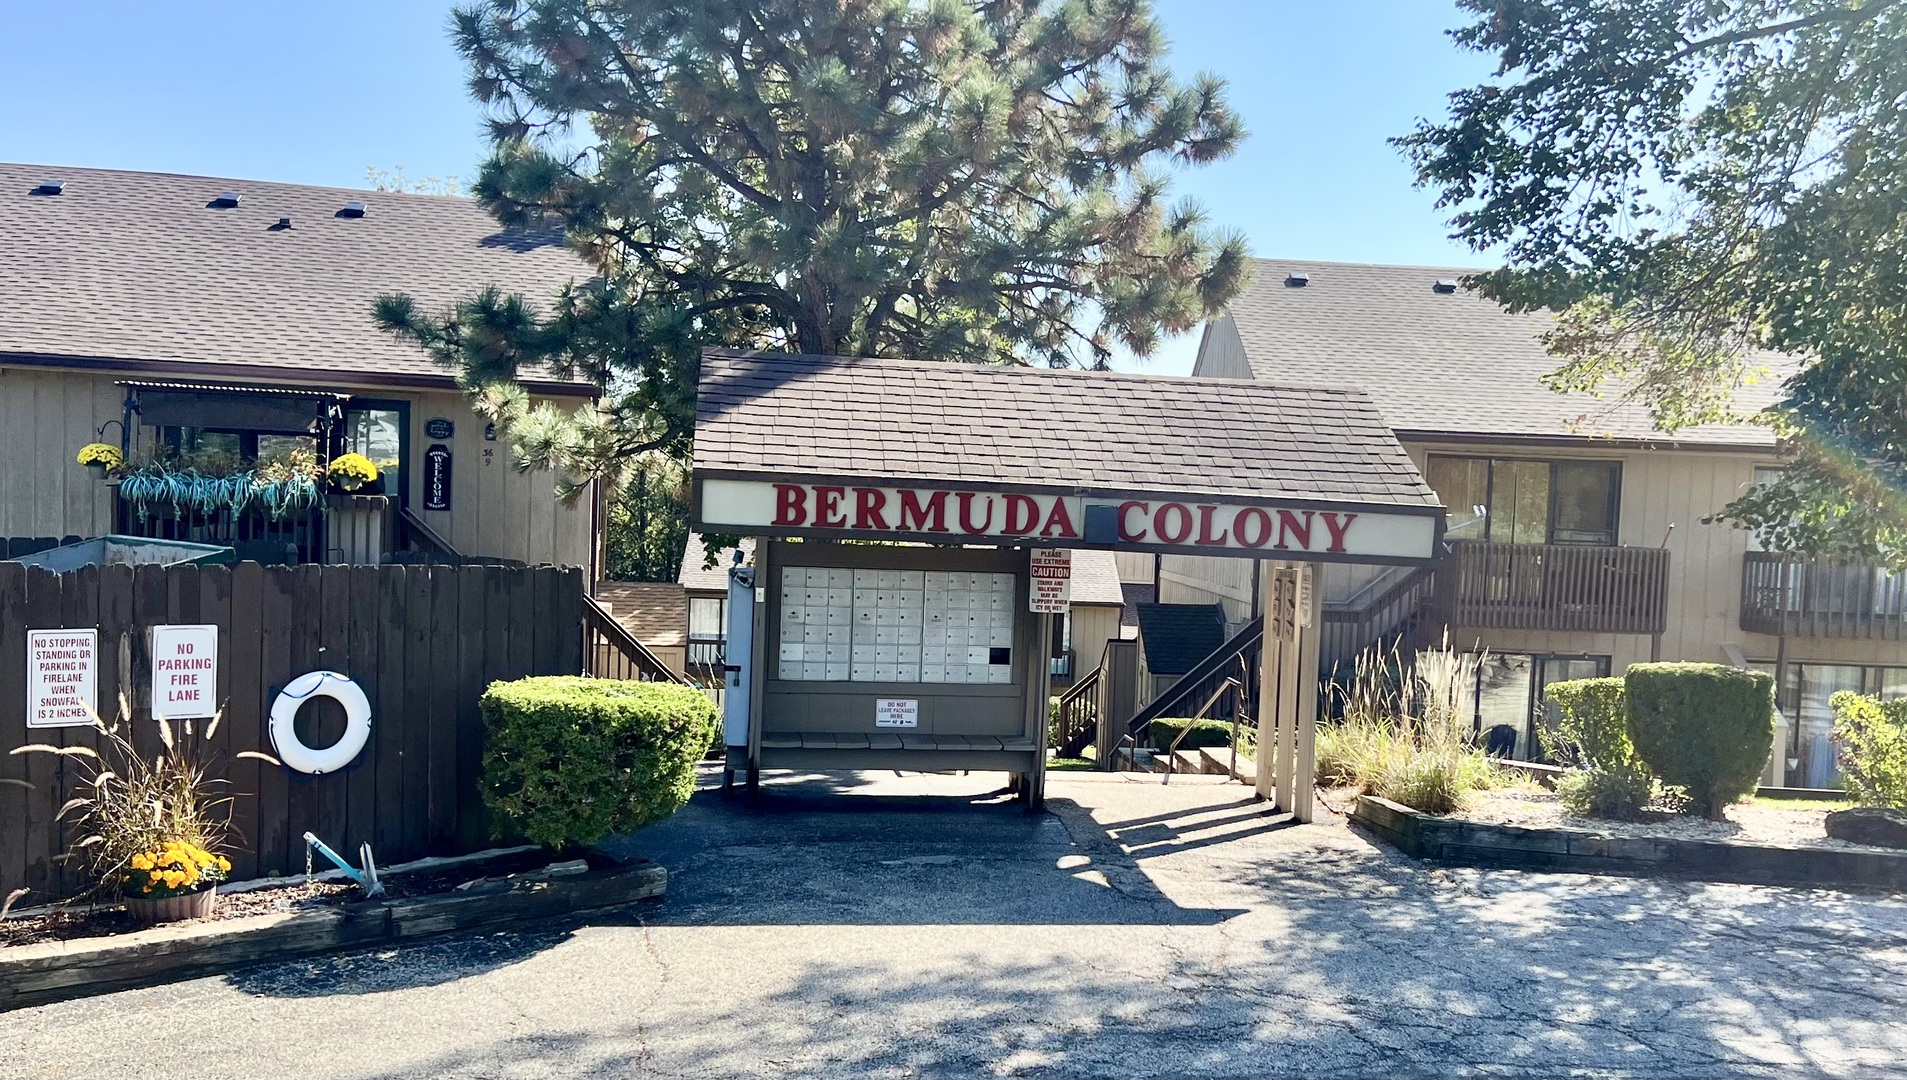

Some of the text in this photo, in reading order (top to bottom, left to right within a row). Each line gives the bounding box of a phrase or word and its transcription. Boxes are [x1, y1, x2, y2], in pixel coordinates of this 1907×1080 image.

[433, 456, 442, 503] WELCOME
[771, 484, 1358, 552] BERMUDA COLONY
[1032, 567, 1069, 577] CAUTION
[35, 639, 46, 648] NO
[178, 644, 194, 654] NO
[36, 650, 90, 660] STANDING OR
[40, 662, 87, 671] PARKING IN
[158, 658, 211, 670] PARKING
[44, 673, 83, 683] FIRELANE
[171, 674, 197, 685] FIRE
[51, 686, 76, 694] WHEN
[169, 690, 200, 701] LANE
[38, 708, 87, 718] IS 2 INCHES
